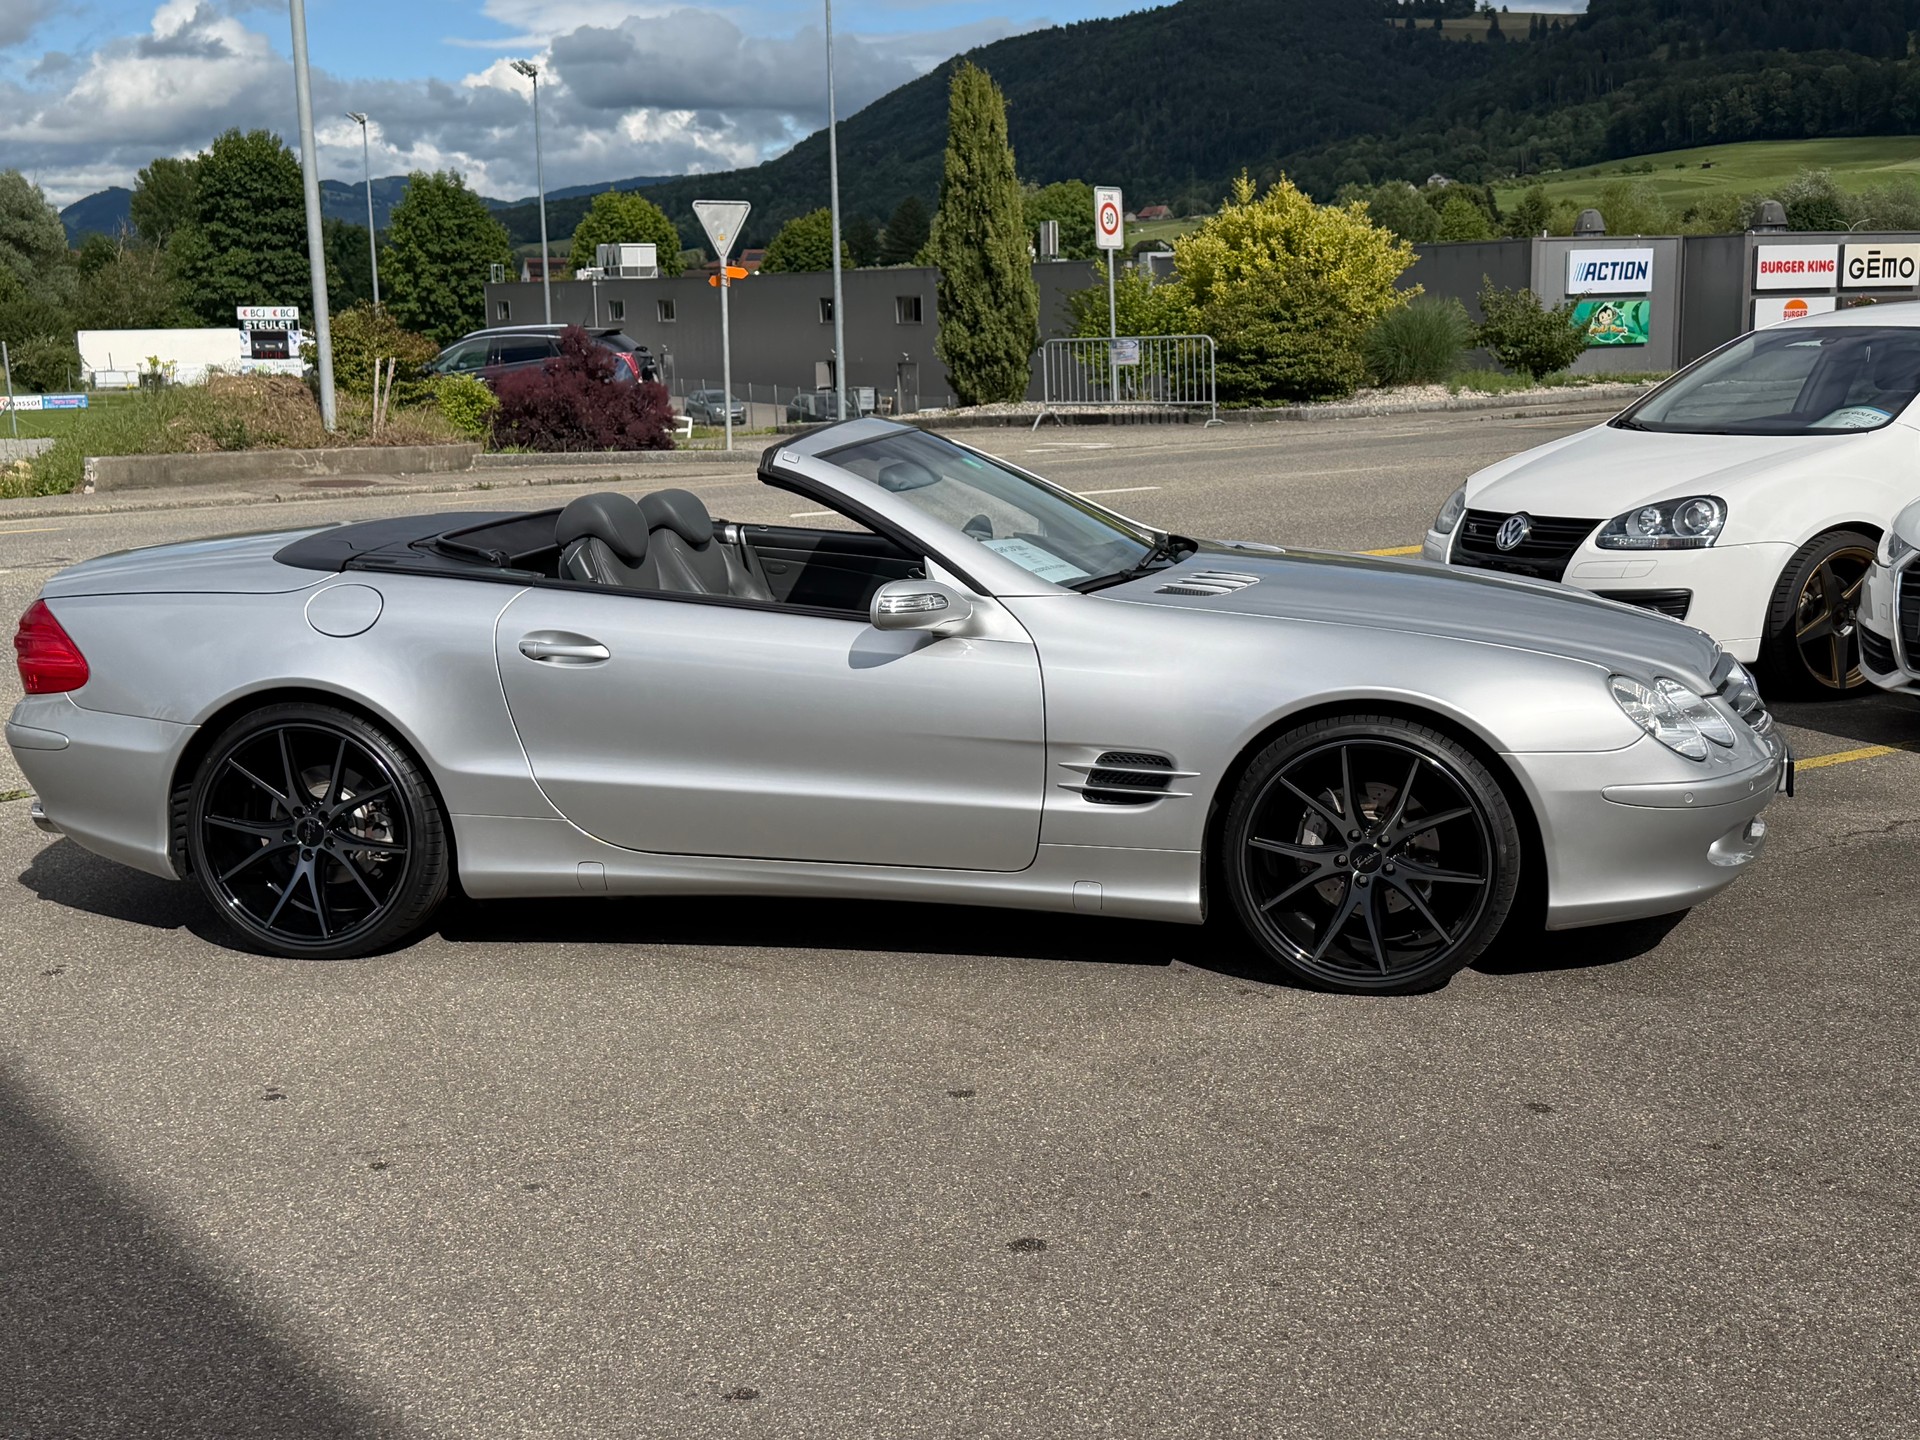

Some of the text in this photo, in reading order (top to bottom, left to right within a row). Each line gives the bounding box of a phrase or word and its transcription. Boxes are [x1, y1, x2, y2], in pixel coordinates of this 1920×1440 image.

[1105, 212, 1114, 225] 30
[1583, 260, 1649, 282] ACTION
[1760, 260, 1835, 274] BURGER KING
[250, 309, 266, 318] BCJ
[280, 309, 296, 318] BCJ
[1783, 310, 1808, 318] BURGER
[244, 320, 293, 330] STEULET
[1498, 516, 1526, 549] VW
